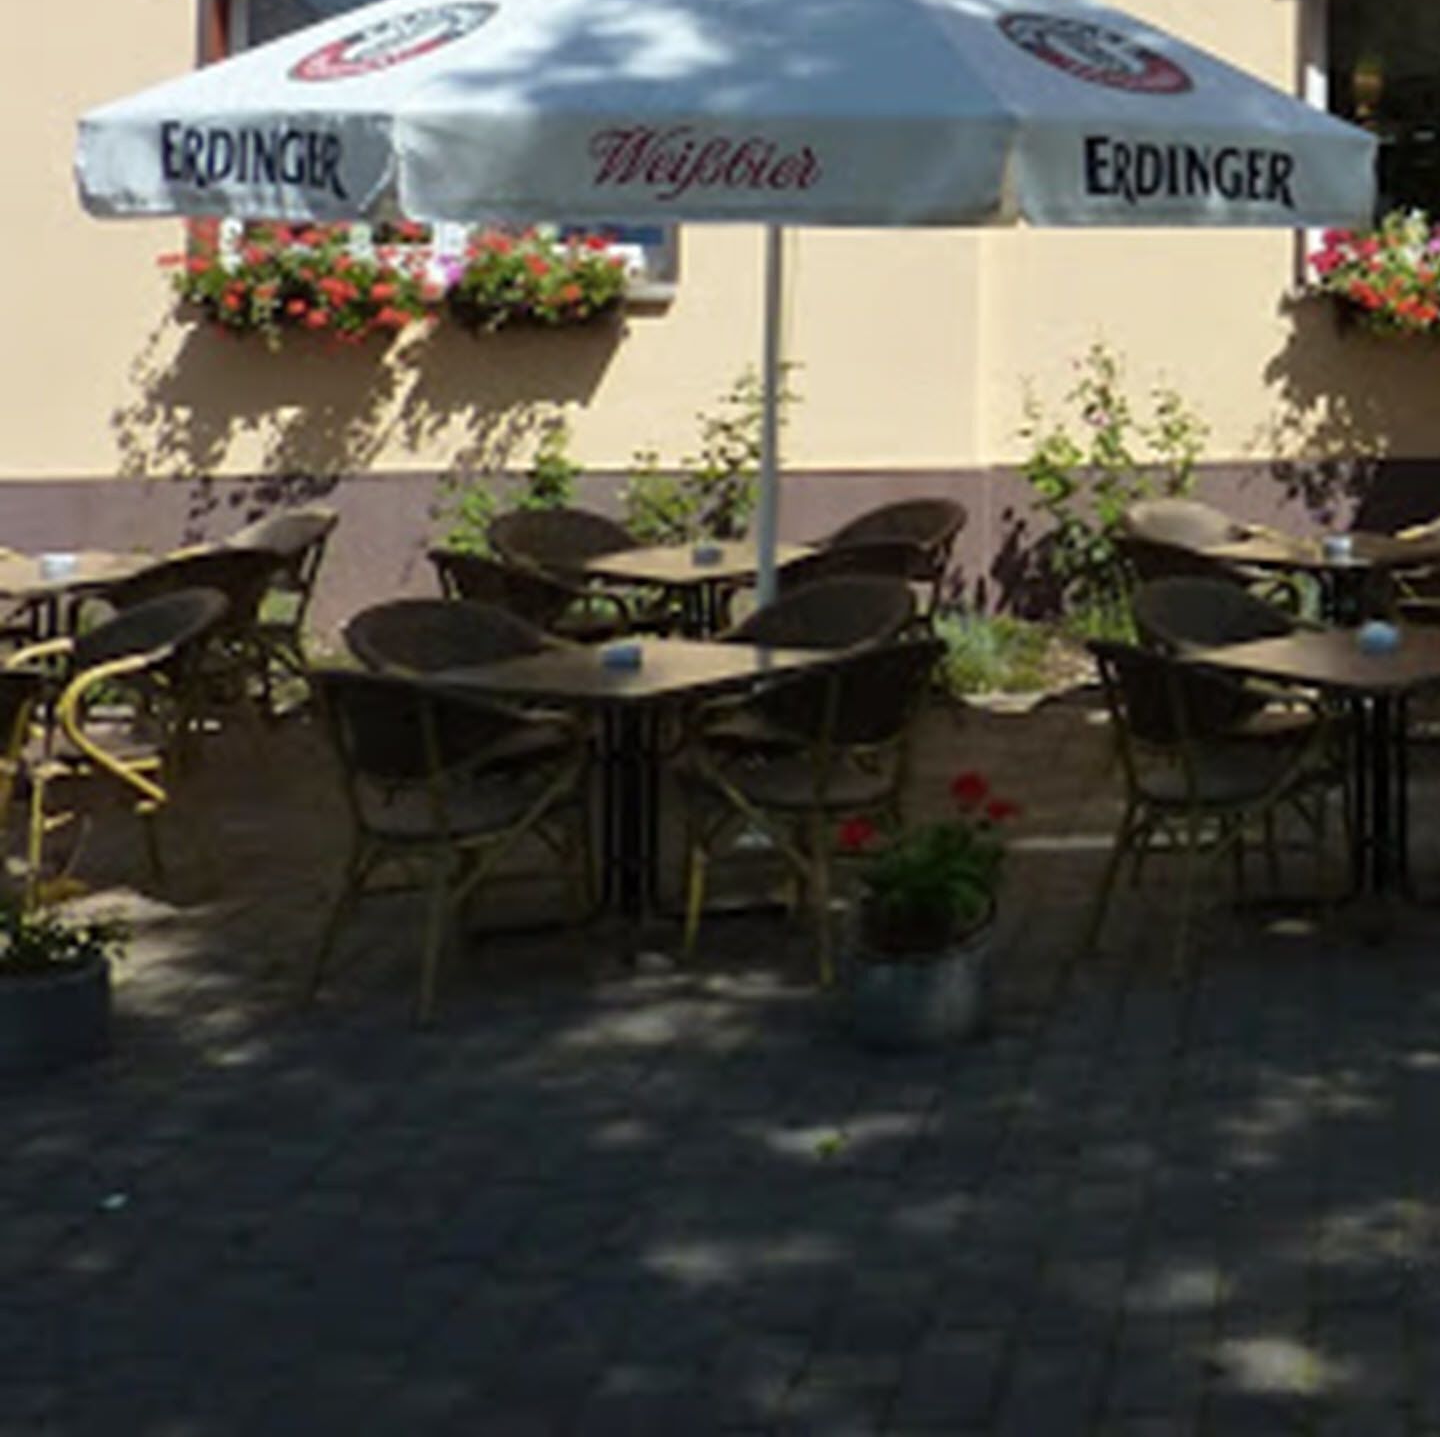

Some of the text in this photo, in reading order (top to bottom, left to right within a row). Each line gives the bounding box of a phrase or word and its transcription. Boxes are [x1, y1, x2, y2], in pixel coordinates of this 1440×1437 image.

[160, 121, 346, 201] ERDINGER
[589, 124, 822, 200] Weißbier
[1083, 136, 1297, 208] ERDINGER
